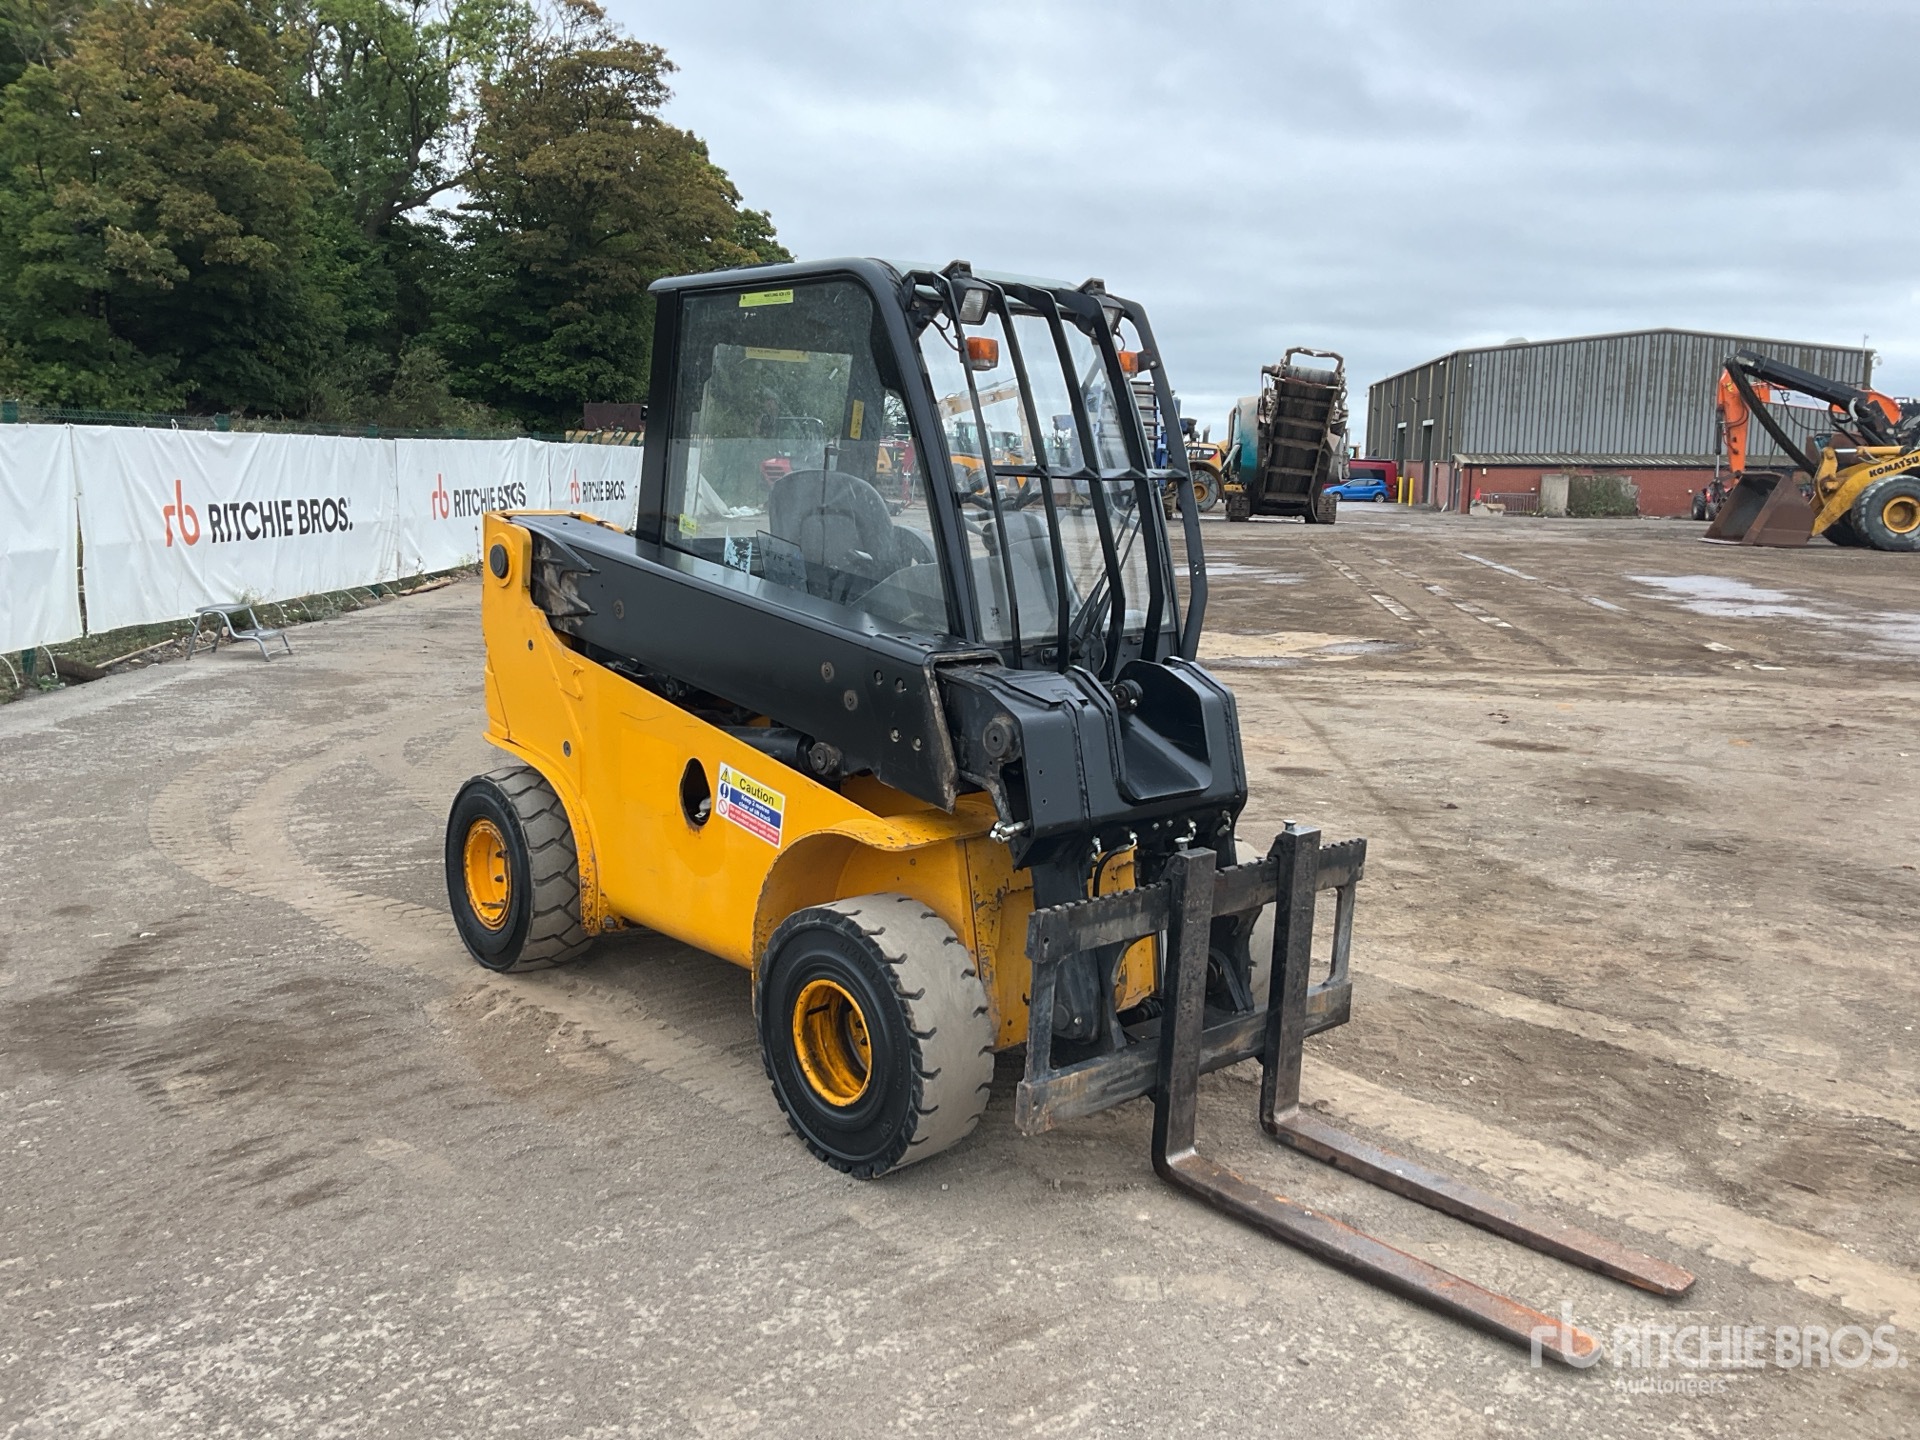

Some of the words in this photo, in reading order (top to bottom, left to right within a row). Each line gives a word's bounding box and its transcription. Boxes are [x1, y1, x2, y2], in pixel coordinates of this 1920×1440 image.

[1869, 456, 1919, 477] KOMATSU
[453, 487, 496, 517] RITCHIE
[582, 480, 604, 503] RITCHIE
[208, 500, 293, 543] RITCHIE
[297, 497, 353, 535] BROS.
[740, 778, 774, 806] Caution
[739, 801, 748, 810] clear
[760, 812, 770, 822] truck
[741, 794, 751, 805] Keep
[755, 802, 770, 814] metres
